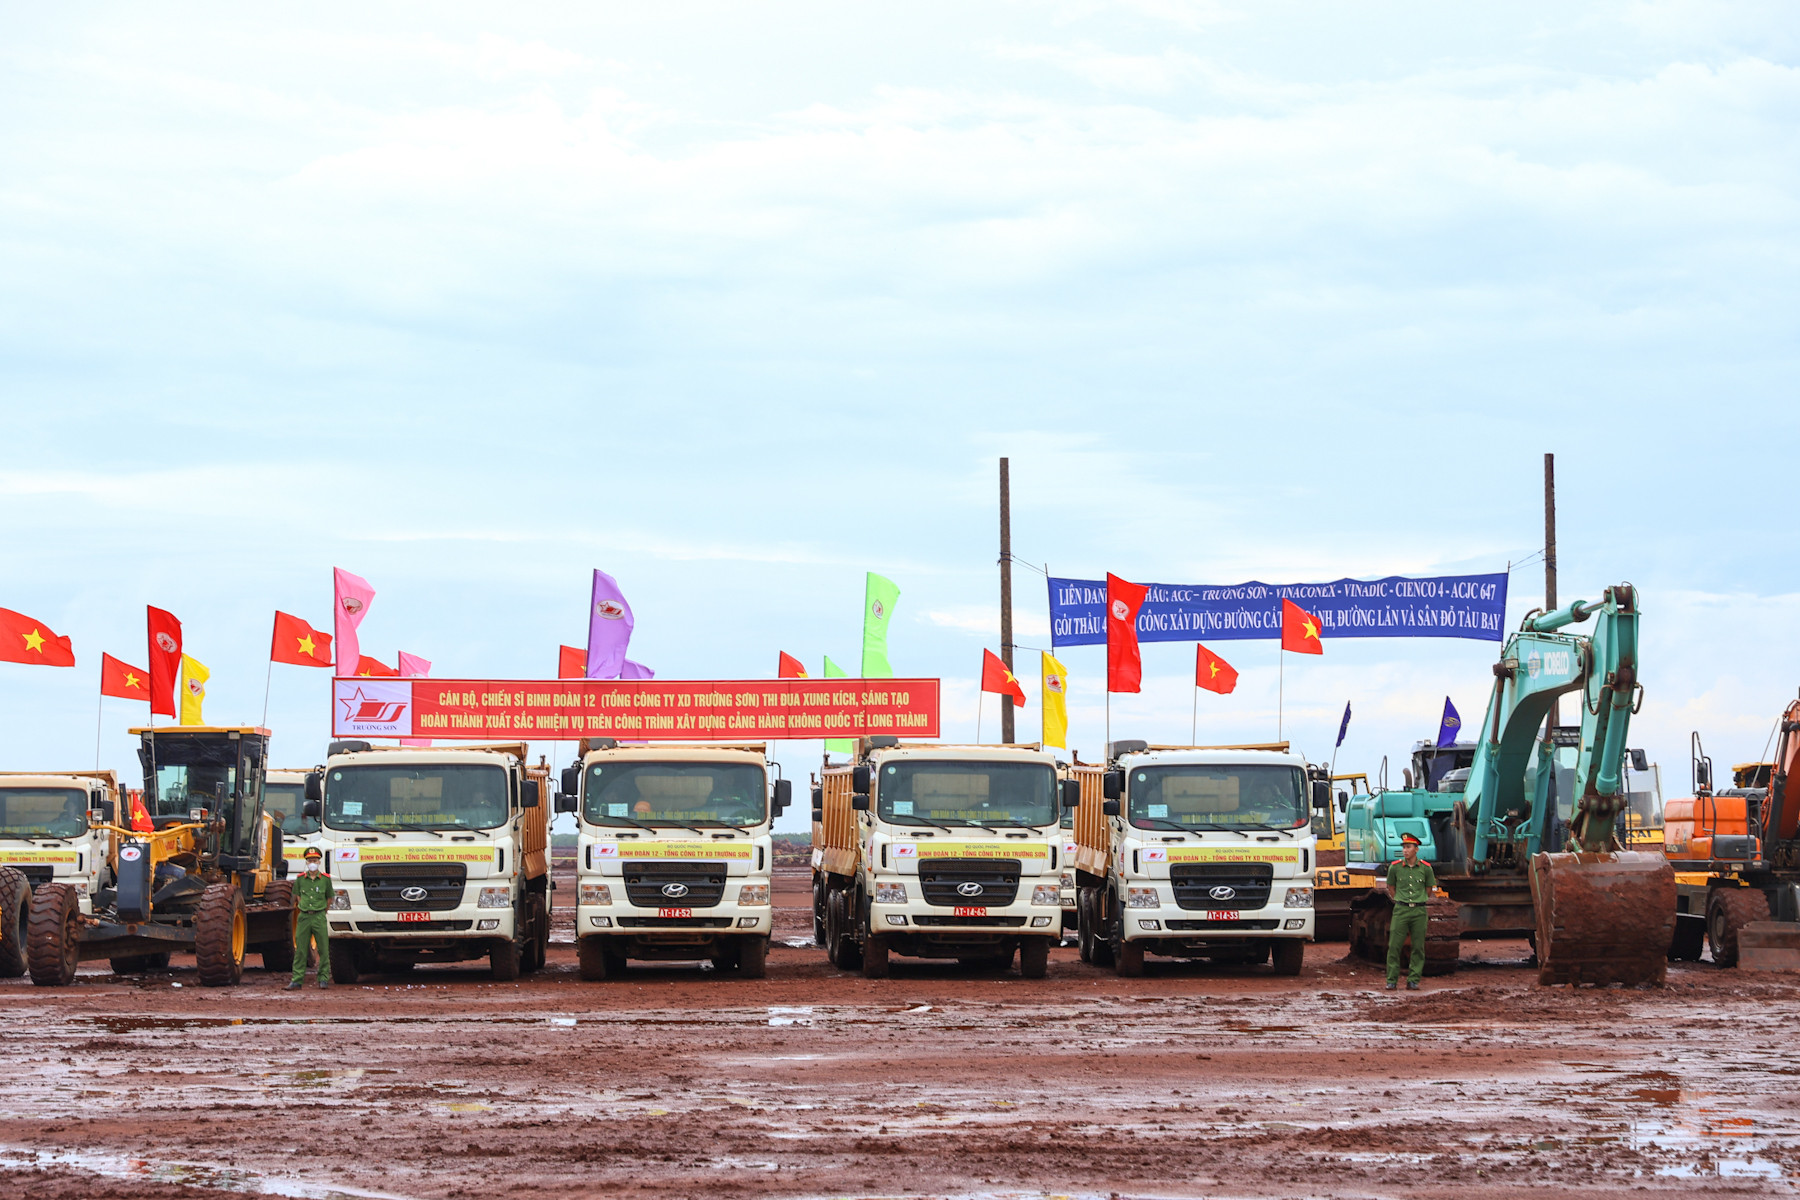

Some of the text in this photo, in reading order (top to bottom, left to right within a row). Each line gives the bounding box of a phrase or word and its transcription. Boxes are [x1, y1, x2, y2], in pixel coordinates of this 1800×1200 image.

[1059, 584, 1082, 605] LIÊN
[1084, 588, 1107, 604] DAN
[1171, 590, 1193, 601] ACC
[1247, 586, 1268, 599] SƠN
[1277, 584, 1336, 598] VINACONEX
[1344, 583, 1387, 597] VINADIC
[1395, 582, 1436, 597] CIENCO
[1438, 582, 1444, 597] 4
[1451, 582, 1478, 599] ACJC
[1480, 583, 1496, 600] 647
[1055, 613, 1072, 636] GÓI
[1074, 612, 1100, 634] THẦU
[1139, 609, 1168, 632] CÔNG
[1170, 608, 1191, 630] XÂY
[1193, 610, 1222, 634] DỰNG
[1224, 606, 1261, 629] ĐƯỜNG
[1338, 605, 1375, 627] ĐƯỜNG
[1378, 605, 1398, 626] LĂN
[1401, 604, 1416, 626] VÀ
[1418, 604, 1438, 626] SÂN
[1440, 606, 1456, 627] ĐỖ
[1458, 606, 1479, 628] TÀU
[1481, 612, 1501, 630] BAY
[439, 689, 910, 709] CÁN BỘ, CHIẾN SĨ BINH ĐOÀN 12 (TỔNG CÔNG TY XD TRƯỜNG SƠN) THI ĐUA XUNG KÍCH, SÁNG TẠO
[421, 710, 928, 732] HOÀN THÀNH XUẤT SẮC NHIỆM VỤ TRÊN CÔNG TRÌNH XÂY DỰNG CẢNG HÀNG KHÔNG QUỐC TẾ LONG THÀNH
